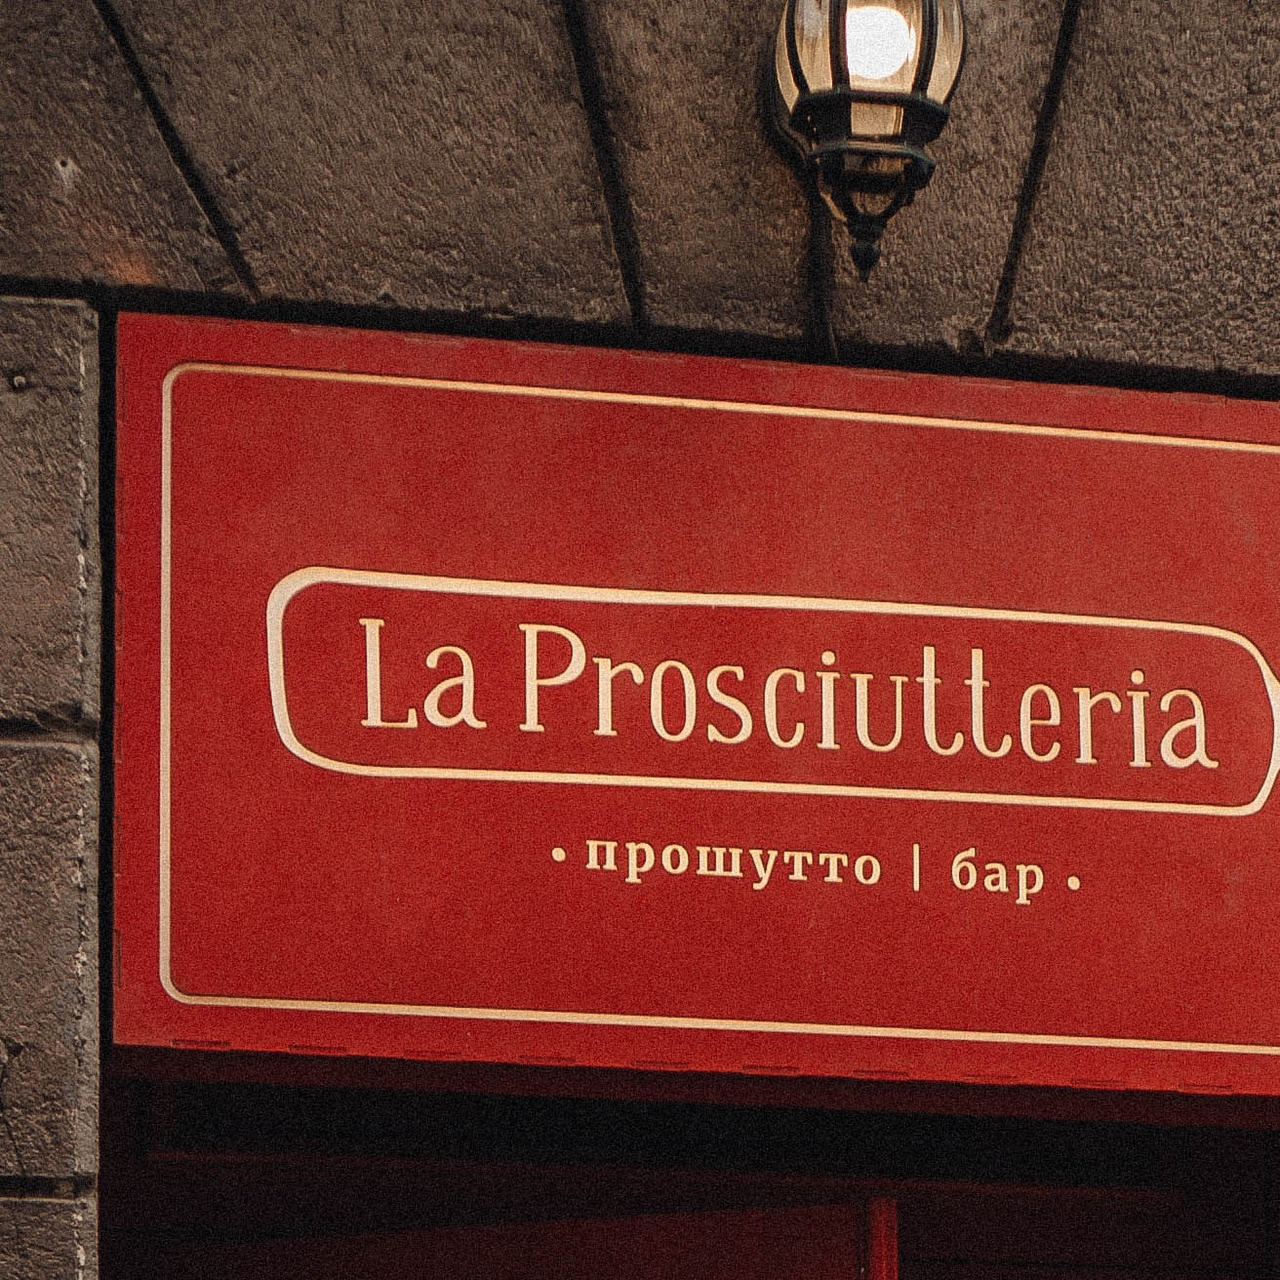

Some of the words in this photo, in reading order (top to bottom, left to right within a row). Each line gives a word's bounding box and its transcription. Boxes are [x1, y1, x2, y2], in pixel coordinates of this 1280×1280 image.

[358, 617, 488, 730] La
[518, 622, 1221, 770] Prosciutteria
[584, 838, 882, 891] прошутто
[950, 846, 1045, 905] бар
